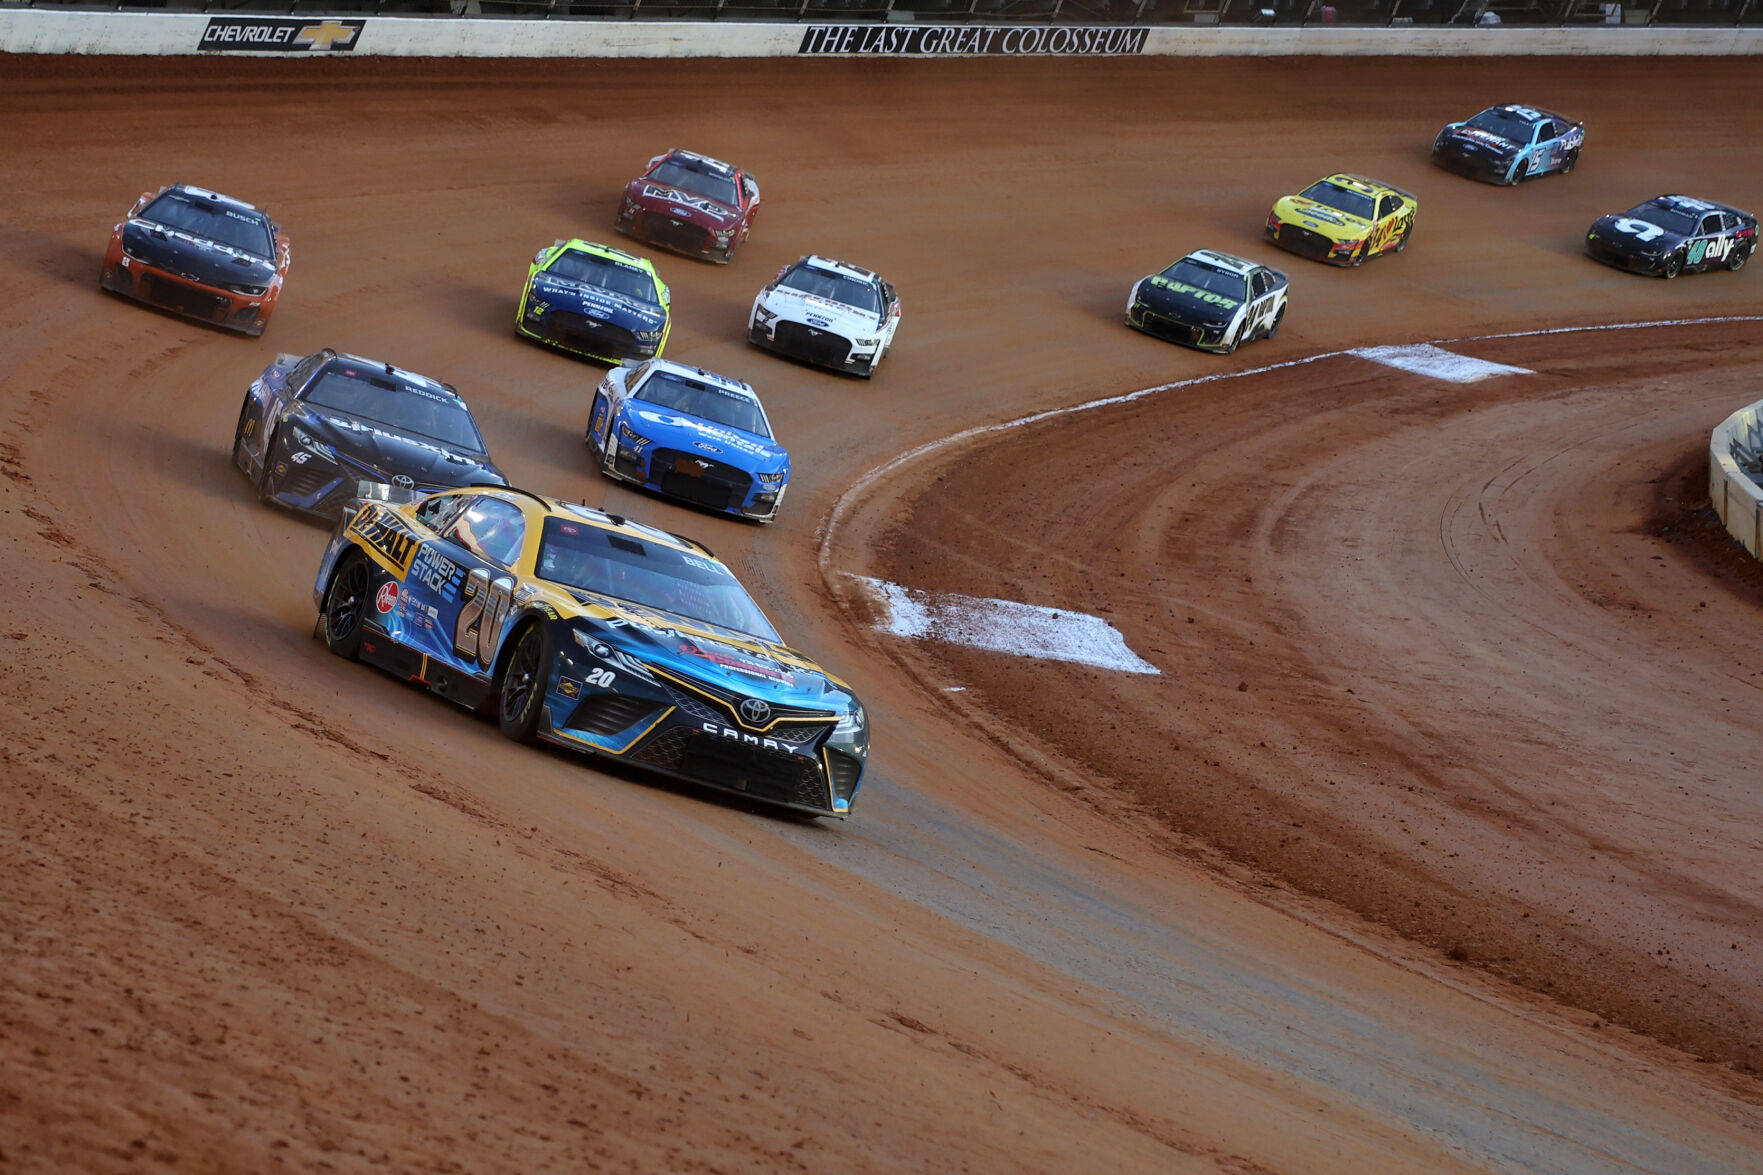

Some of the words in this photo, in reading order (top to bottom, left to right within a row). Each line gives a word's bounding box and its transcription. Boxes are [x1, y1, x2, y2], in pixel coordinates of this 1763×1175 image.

[204, 25, 295, 43] CHEVROLET
[806, 27, 857, 53] THE
[858, 27, 918, 53] LAST
[920, 28, 1000, 53] GREAT
[1001, 28, 1145, 54] COLOSSEUM
[226, 210, 258, 225] BUSCH
[1687, 240, 1708, 264] 48
[1706, 234, 1734, 262] ally
[615, 261, 643, 274] BLANEY
[1216, 268, 1239, 279] BYRON
[1151, 276, 1239, 310] RAPTOR
[534, 305, 545, 315] 12
[543, 287, 576, 296] WHAT'S
[579, 293, 611, 305] INSIDE
[614, 303, 655, 325] MATTERS
[582, 301, 614, 314] PENNZOIL
[405, 385, 450, 404] REDDICK
[718, 389, 751, 403] PREECE
[633, 446, 644, 454] 41
[696, 441, 720, 453] Ford
[291, 451, 312, 465] 45
[418, 543, 456, 580] POWER
[682, 555, 724, 576] BELL
[410, 561, 448, 595] STACK
[454, 568, 516, 672] 20
[585, 667, 616, 688] 20
[703, 722, 800, 754] CAMRY
